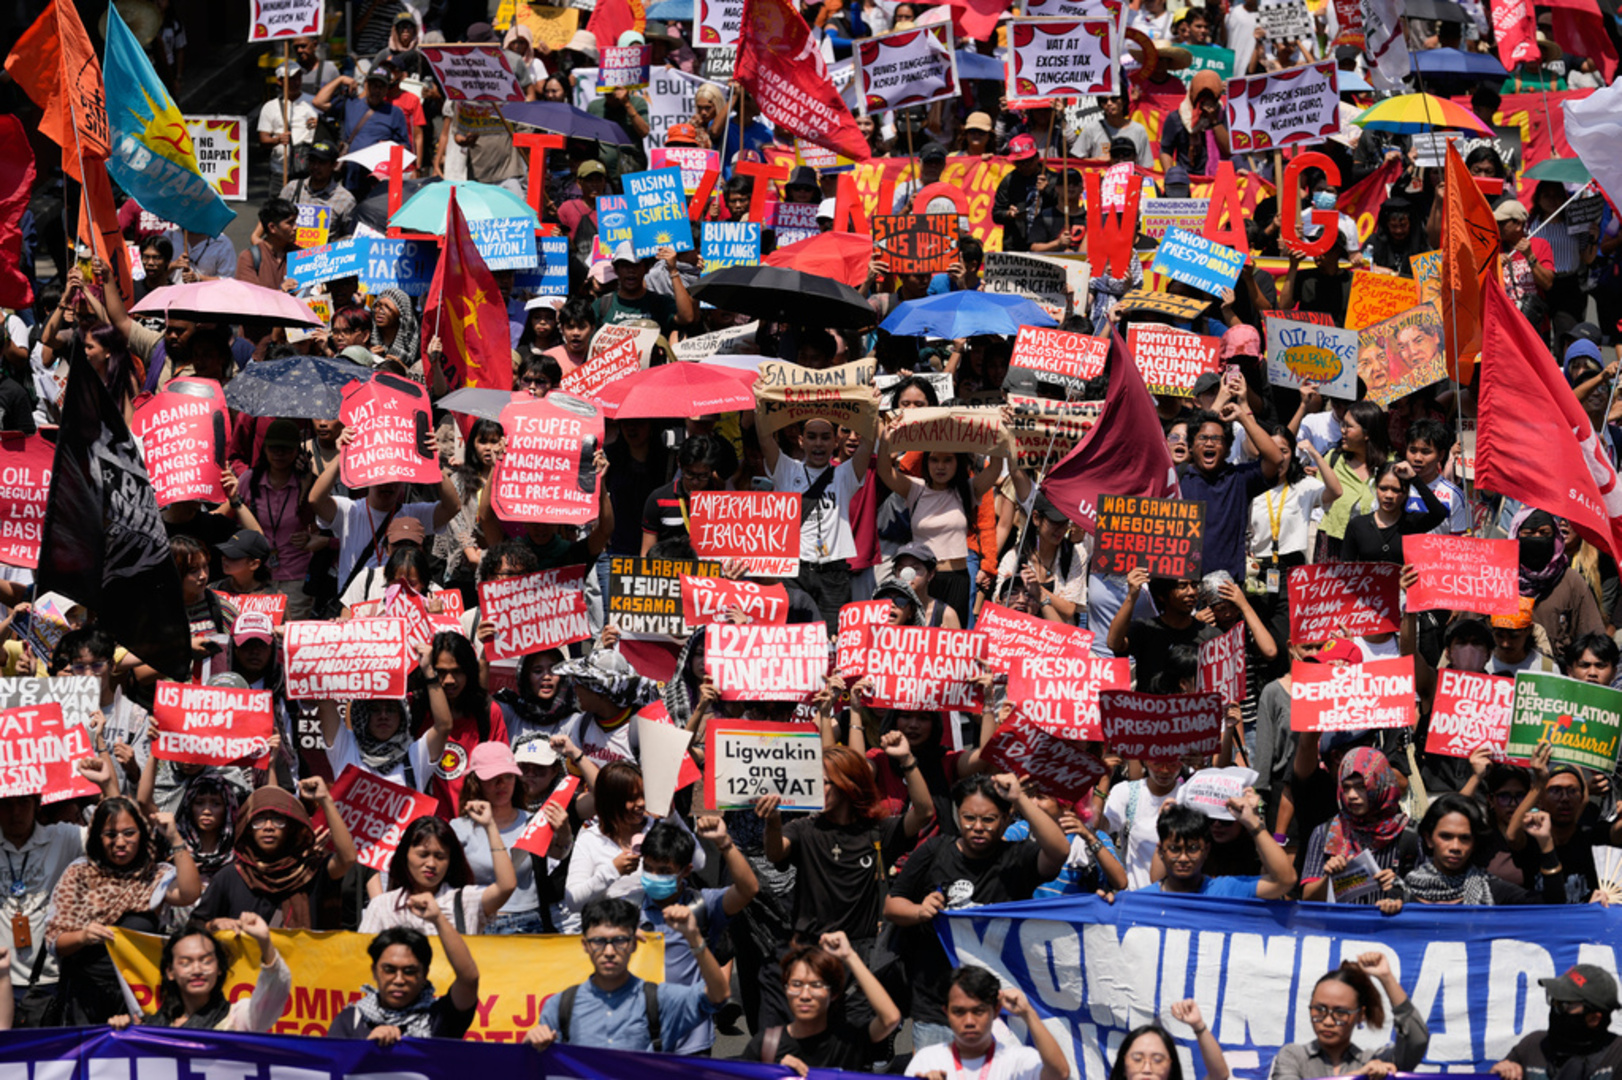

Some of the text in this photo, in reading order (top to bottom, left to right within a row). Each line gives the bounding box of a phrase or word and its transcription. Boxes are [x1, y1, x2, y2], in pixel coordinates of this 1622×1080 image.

[1046, 38, 1080, 50] VAT AT
[872, 64, 898, 77] BUWIS
[1036, 55, 1091, 67] EXCISE TAX
[874, 76, 899, 88] KORAP
[1035, 71, 1095, 84] TANGGALIN!
[1294, 82, 1326, 98] SWELDO
[1265, 107, 1277, 119] SA
[1278, 104, 1296, 117] MGA
[1270, 112, 1320, 131] NGAYON NA!
[810, 116, 828, 133] NA
[200, 138, 214, 148] NG
[200, 150, 232, 160] DAPAT
[666, 150, 706, 160] SAHOD
[630, 174, 676, 195] BUSINA
[638, 191, 678, 208] PARA SA
[1147, 201, 1197, 210] BONGBONG
[633, 202, 687, 226] TSUPER!
[480, 230, 508, 242] VAT
[704, 223, 757, 242] BUWIS
[874, 214, 958, 241] STOP THE
[707, 244, 756, 258] SA LANGIS
[887, 232, 951, 258] US WAR
[1162, 242, 1208, 265] PRESYO
[1170, 228, 1208, 249] SAHOD
[1210, 244, 1242, 264] ITAAS
[994, 280, 1044, 293] OIL PRICE
[1018, 328, 1088, 351] MARCOS
[1280, 328, 1357, 360] OIL PRICE
[1014, 344, 1065, 358] KASOSYO
[1136, 344, 1216, 362] MAKIBAKA!
[765, 364, 786, 386] SA
[791, 367, 846, 386] LABAN
[1135, 356, 1202, 374] BAGUHIN
[142, 402, 210, 435] LABANAN
[348, 398, 398, 424] VAT at
[154, 422, 188, 443] TAAS
[351, 416, 414, 438] EXCISE TAX
[514, 416, 582, 436] TSUPER
[1014, 418, 1036, 431] NG
[364, 430, 415, 450] LANGIS
[513, 436, 578, 452] KOMYUTER
[1016, 436, 1069, 448] KASAMA
[148, 438, 195, 464] PRESYO
[348, 450, 423, 470] TANGGALIN
[147, 453, 198, 482] LANGIS
[504, 452, 572, 472] MAGKAISA
[2, 468, 36, 486] OIL
[502, 471, 544, 484] LABAN
[500, 485, 593, 504] OIL PRICE HIKE
[690, 493, 798, 520] IMPERYALISMO
[1104, 497, 1198, 520] WAG GAWING
[1110, 516, 1184, 536] NEGOSYO
[698, 524, 789, 552] IBAGSAK!
[1100, 533, 1190, 556] SERBISYO
[612, 558, 633, 574] SA
[642, 559, 692, 578] LABAN
[698, 562, 720, 578] NG
[1114, 554, 1185, 577] SA TAO
[686, 576, 760, 594] NO TO
[1292, 570, 1308, 584] SA
[1420, 574, 1514, 600] NA SISTEMA!
[610, 596, 676, 614] KASAMA
[734, 594, 784, 622] VAT
[864, 604, 890, 625] NG
[1295, 596, 1384, 618] KASAMA ANG
[290, 620, 401, 645] ISABANSA
[494, 613, 591, 659] KABUHAYAN
[708, 625, 828, 658] 12% VAT SA
[871, 626, 987, 658] YOUTH FIGHT
[339, 642, 402, 658] PETRON
[290, 660, 315, 674] AT
[868, 651, 916, 676] BACK
[1022, 657, 1115, 683] PRESYO NG
[1332, 664, 1372, 678] OIL
[48, 676, 100, 694] WIKA
[289, 672, 392, 694] ng LANGIS
[707, 658, 828, 692] TANGGALIN
[1441, 671, 1492, 698] EXTRA
[862, 674, 978, 708] OIL PRICE HIKE
[1034, 680, 1100, 702] LANGIS
[1292, 676, 1413, 700] DEREGULATION
[1518, 682, 1539, 696] OIL
[158, 687, 272, 714] US IMPERIALIST
[1114, 694, 1168, 714] SAHOD
[1023, 700, 1067, 724] ROLL
[1515, 710, 1543, 726] LAW
[1516, 697, 1620, 726] DEREGULATION
[1115, 714, 1218, 736] PRESYO IBABA
[1428, 711, 1488, 740] ADDRESS
[159, 732, 250, 758] TERRORIST
[1538, 720, 1617, 758] Ibasura!
[725, 740, 816, 764] Ligwakin
[748, 766, 786, 783] ang
[728, 778, 769, 796] 12%
[350, 778, 416, 824] IPRENO
